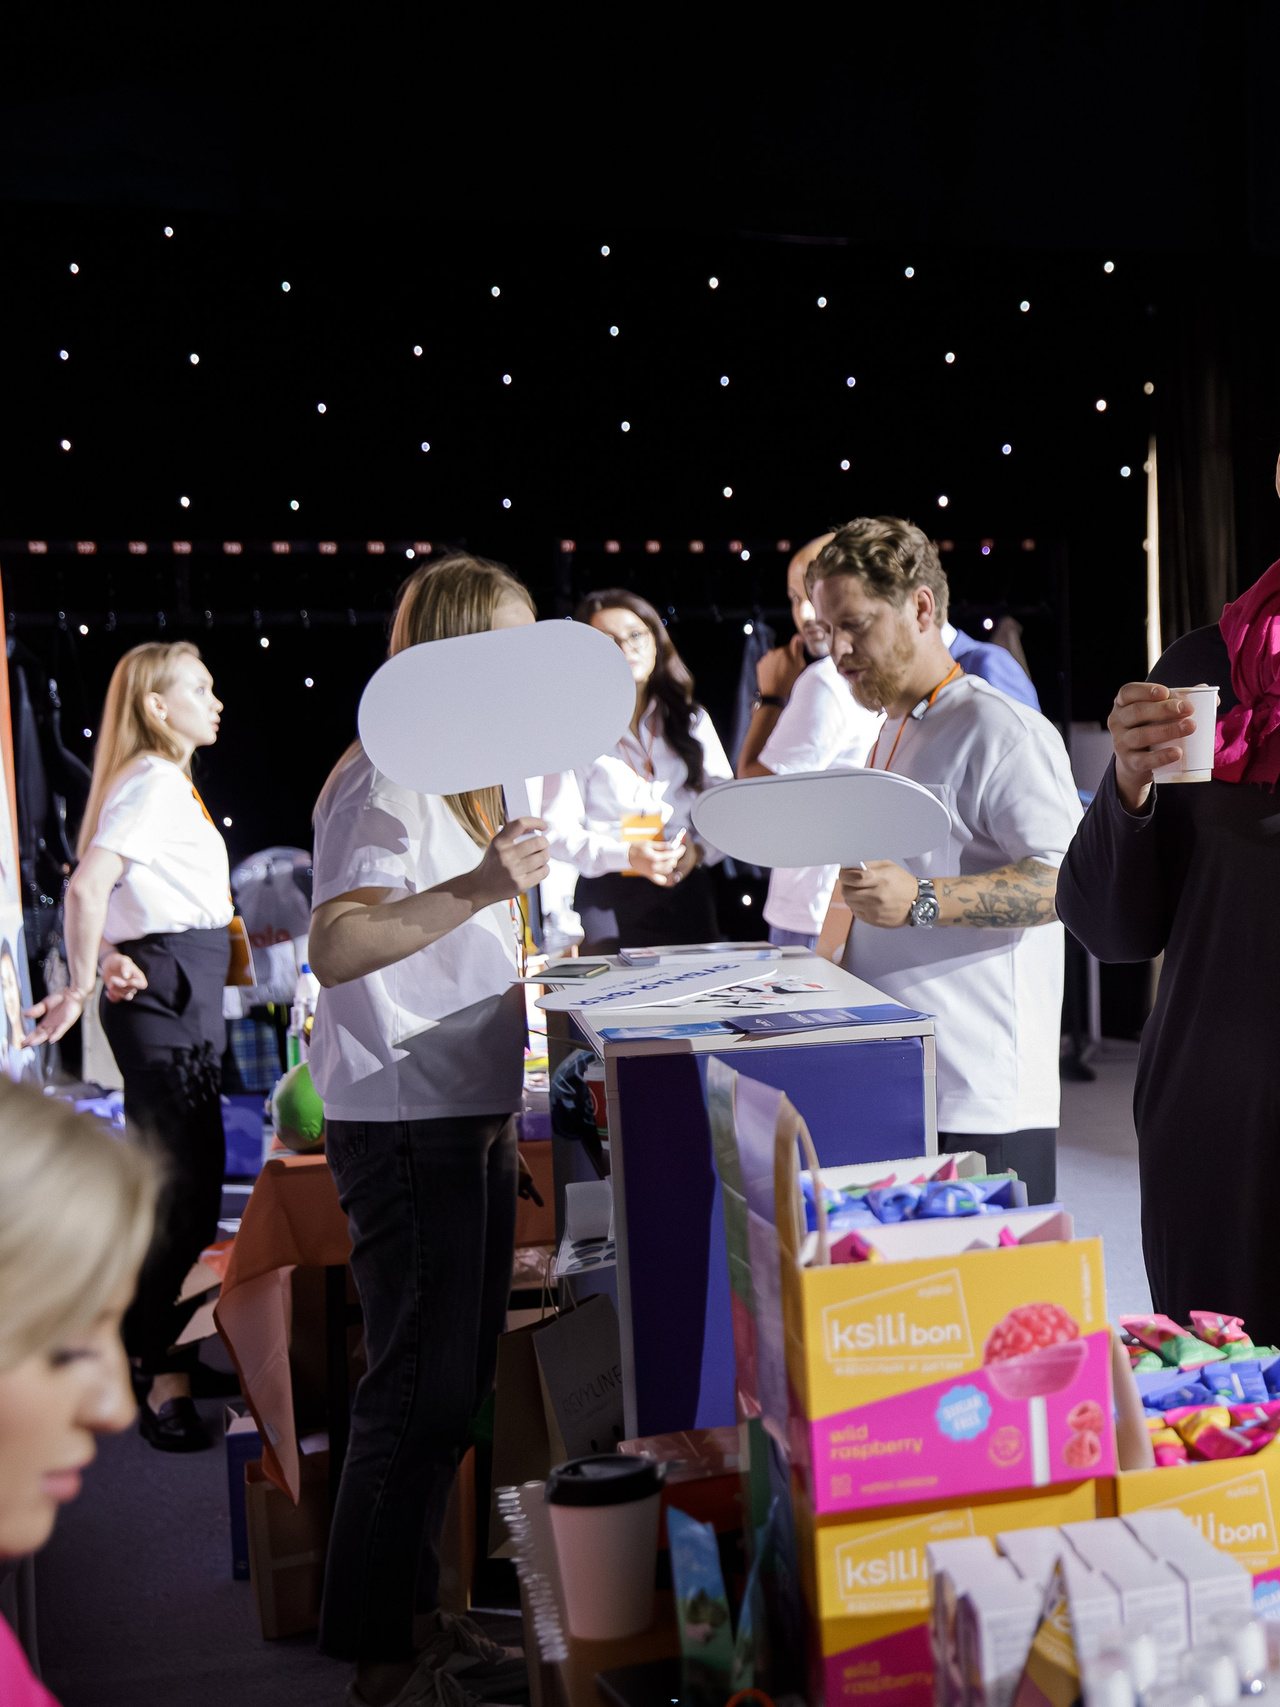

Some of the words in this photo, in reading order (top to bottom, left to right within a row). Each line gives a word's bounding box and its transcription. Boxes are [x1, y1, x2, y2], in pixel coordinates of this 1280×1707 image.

[832, 1313, 907, 1352] ksili
[911, 1321, 962, 1347] bon
[830, 1424, 868, 1443] wild
[830, 1438, 923, 1460] raspberry
[1218, 1522, 1268, 1545] bon
[845, 1547, 917, 1589] ksili
